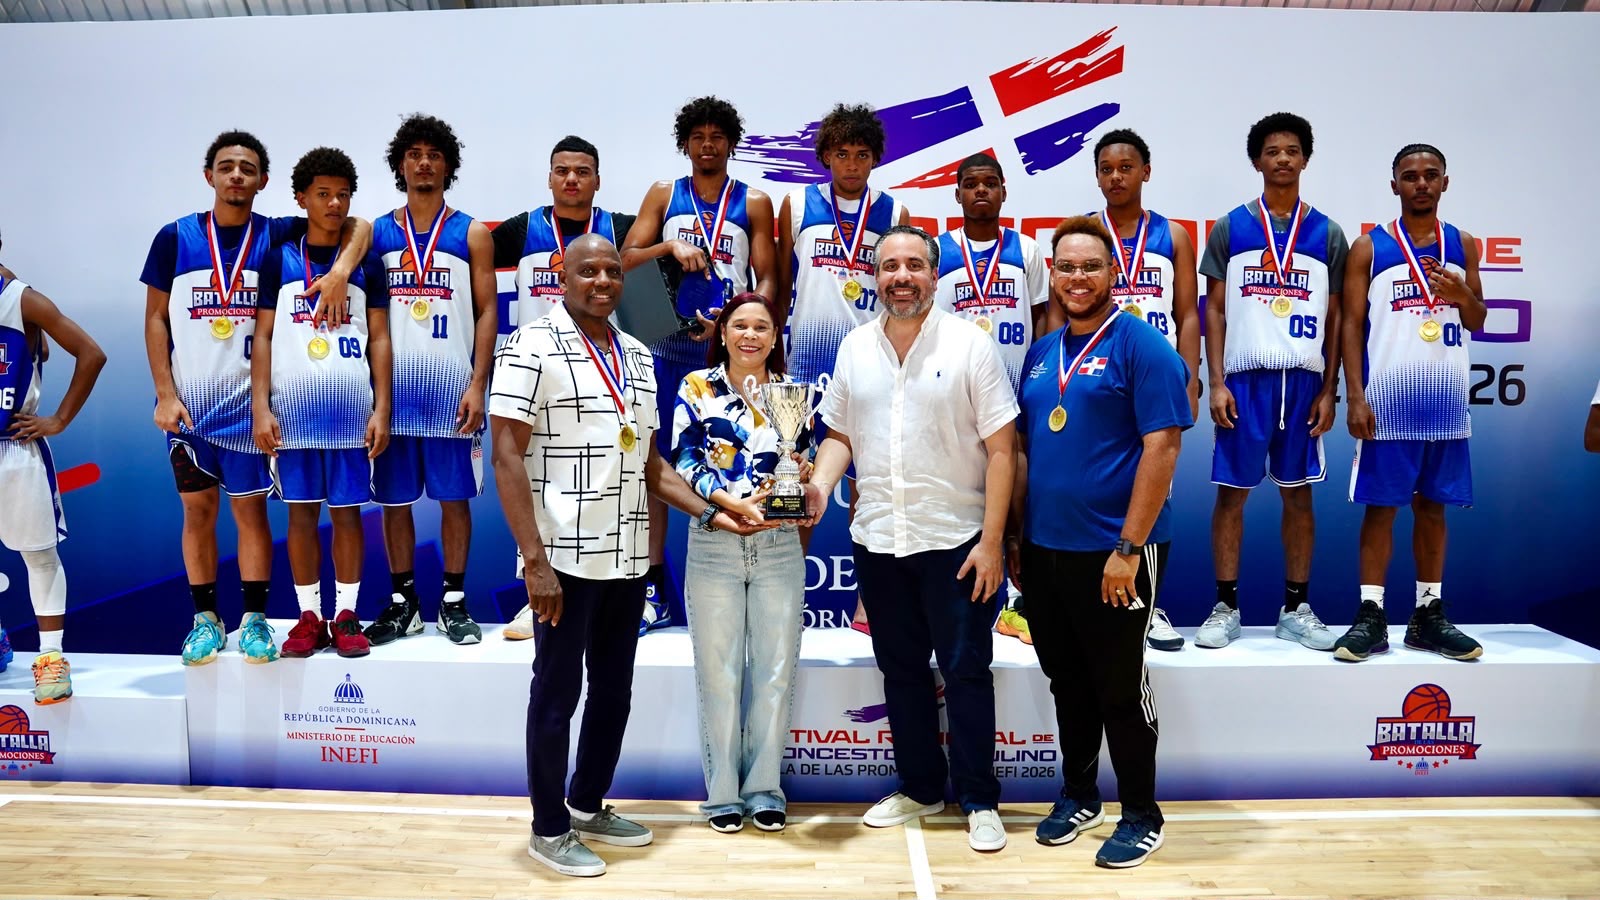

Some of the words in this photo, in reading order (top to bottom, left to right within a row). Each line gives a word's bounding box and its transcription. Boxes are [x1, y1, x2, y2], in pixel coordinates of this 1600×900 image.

[679, 232, 732, 254] BATLA
[815, 243, 875, 263] BATLA
[388, 272, 449, 288] BATLLA
[193, 291, 258, 307] BATLLA
[389, 288, 444, 296] ROMOCIONES
[956, 283, 1015, 301] BALLA
[1248, 286, 1303, 297] PROMOCIONES
[960, 297, 1010, 308] PROMCIONES
[197, 308, 255, 316] PROMOCIONES
[432, 314, 448, 339] 11
[1147, 311, 1168, 336] 03
[1289, 314, 1318, 339] 05
[998, 321, 1025, 346] 08
[338, 336, 362, 358] 09
[0, 387, 15, 410] 6
[318, 705, 357, 714] GOBIERNO
[284, 712, 343, 723] REPÚBLICA
[346, 716, 416, 726] DOMINICANA
[286, 731, 342, 742] MINISTERIO
[344, 734, 356, 742] DE
[360, 735, 415, 744] EDUCACIÓN
[1032, 734, 1054, 742] DE
[1376, 722, 1473, 744] BATALLA
[321, 746, 379, 764] INEFI
[1382, 745, 1466, 756] PROMOCIONES
[801, 764, 820, 775] DE
[825, 764, 853, 776] LAS
[993, 766, 1017, 778] EFI
[1021, 766, 1056, 778] 2026
